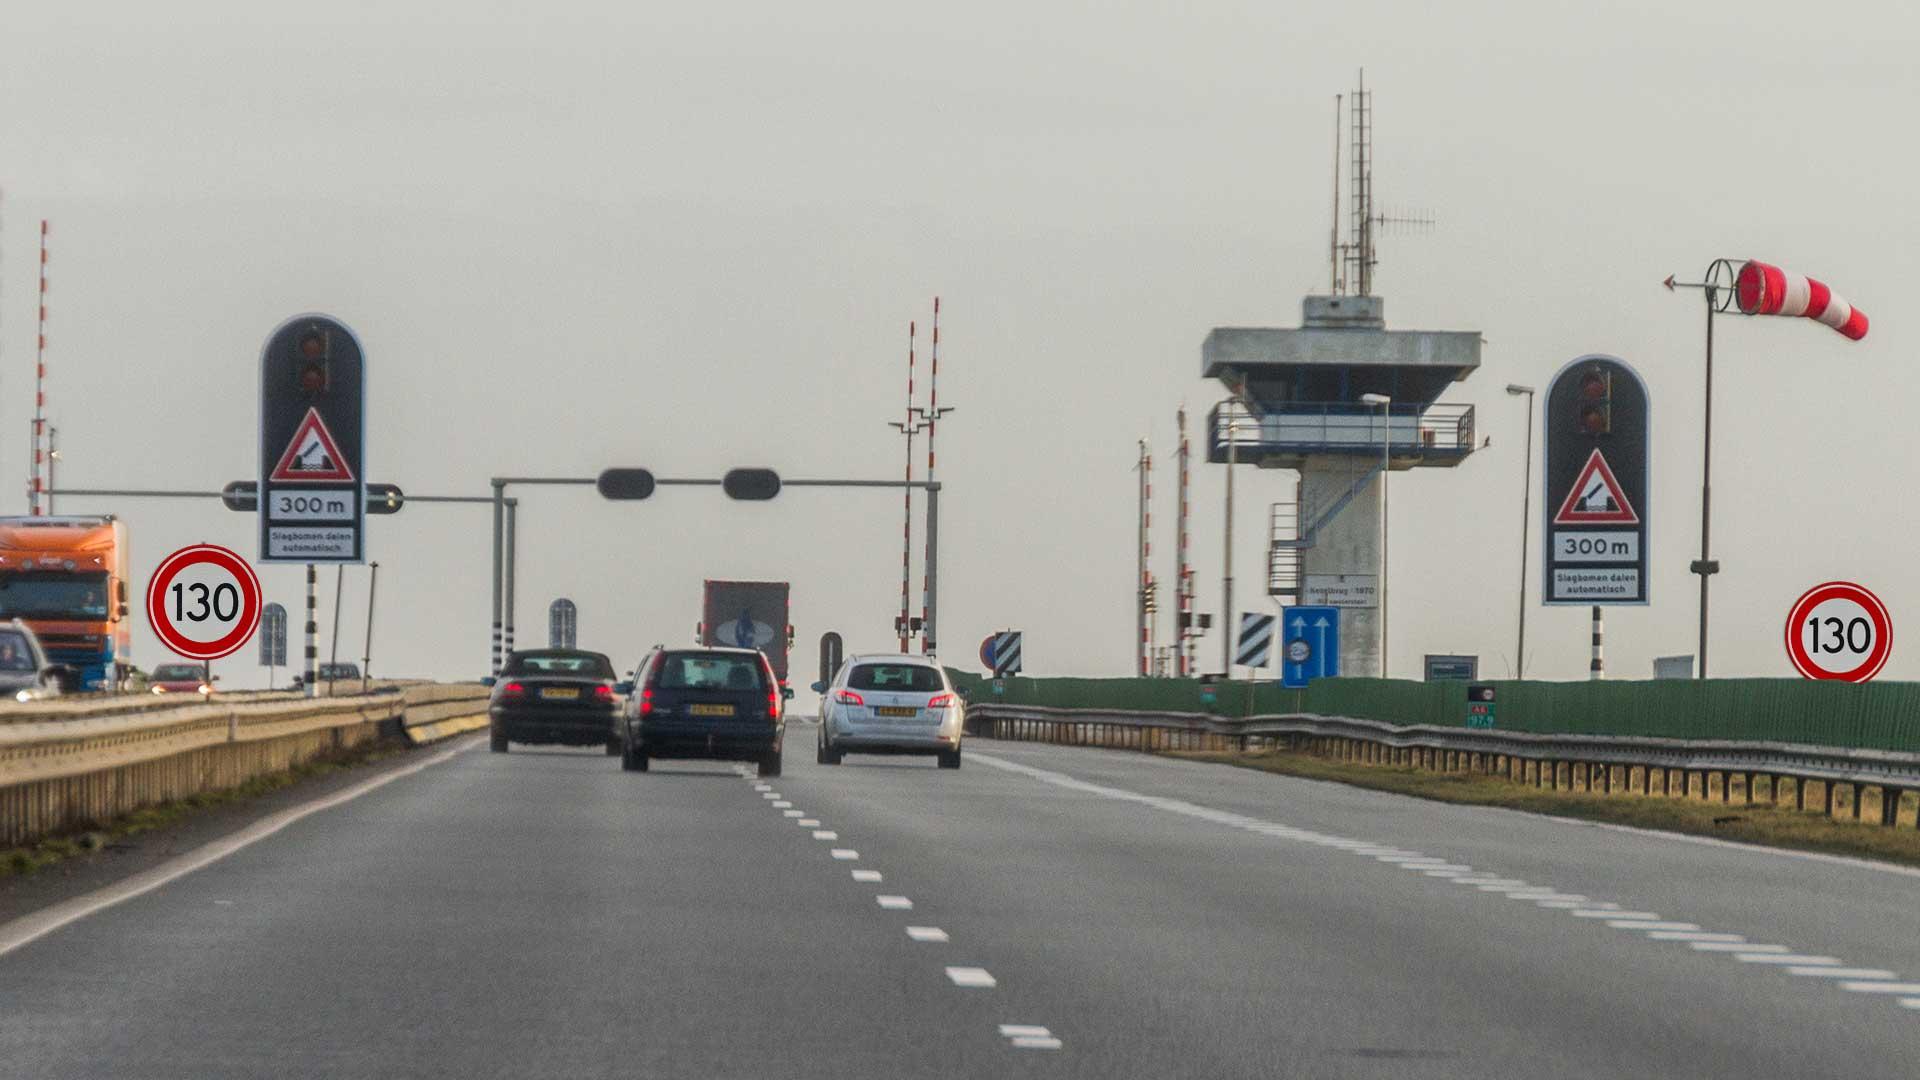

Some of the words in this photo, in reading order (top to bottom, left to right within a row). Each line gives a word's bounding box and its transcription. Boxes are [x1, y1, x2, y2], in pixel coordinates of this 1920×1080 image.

[280, 497, 322, 513] 300
[327, 501, 344, 513] m
[282, 544, 341, 552] automatisch
[1565, 538, 1607, 554] 300
[1612, 542, 1629, 554] m
[1557, 574, 1608, 583] Slagbomen
[1610, 574, 1636, 582] dalen
[1566, 585, 1626, 593] automatisch
[172, 582, 239, 622] 130
[1809, 617, 1871, 653] 130
